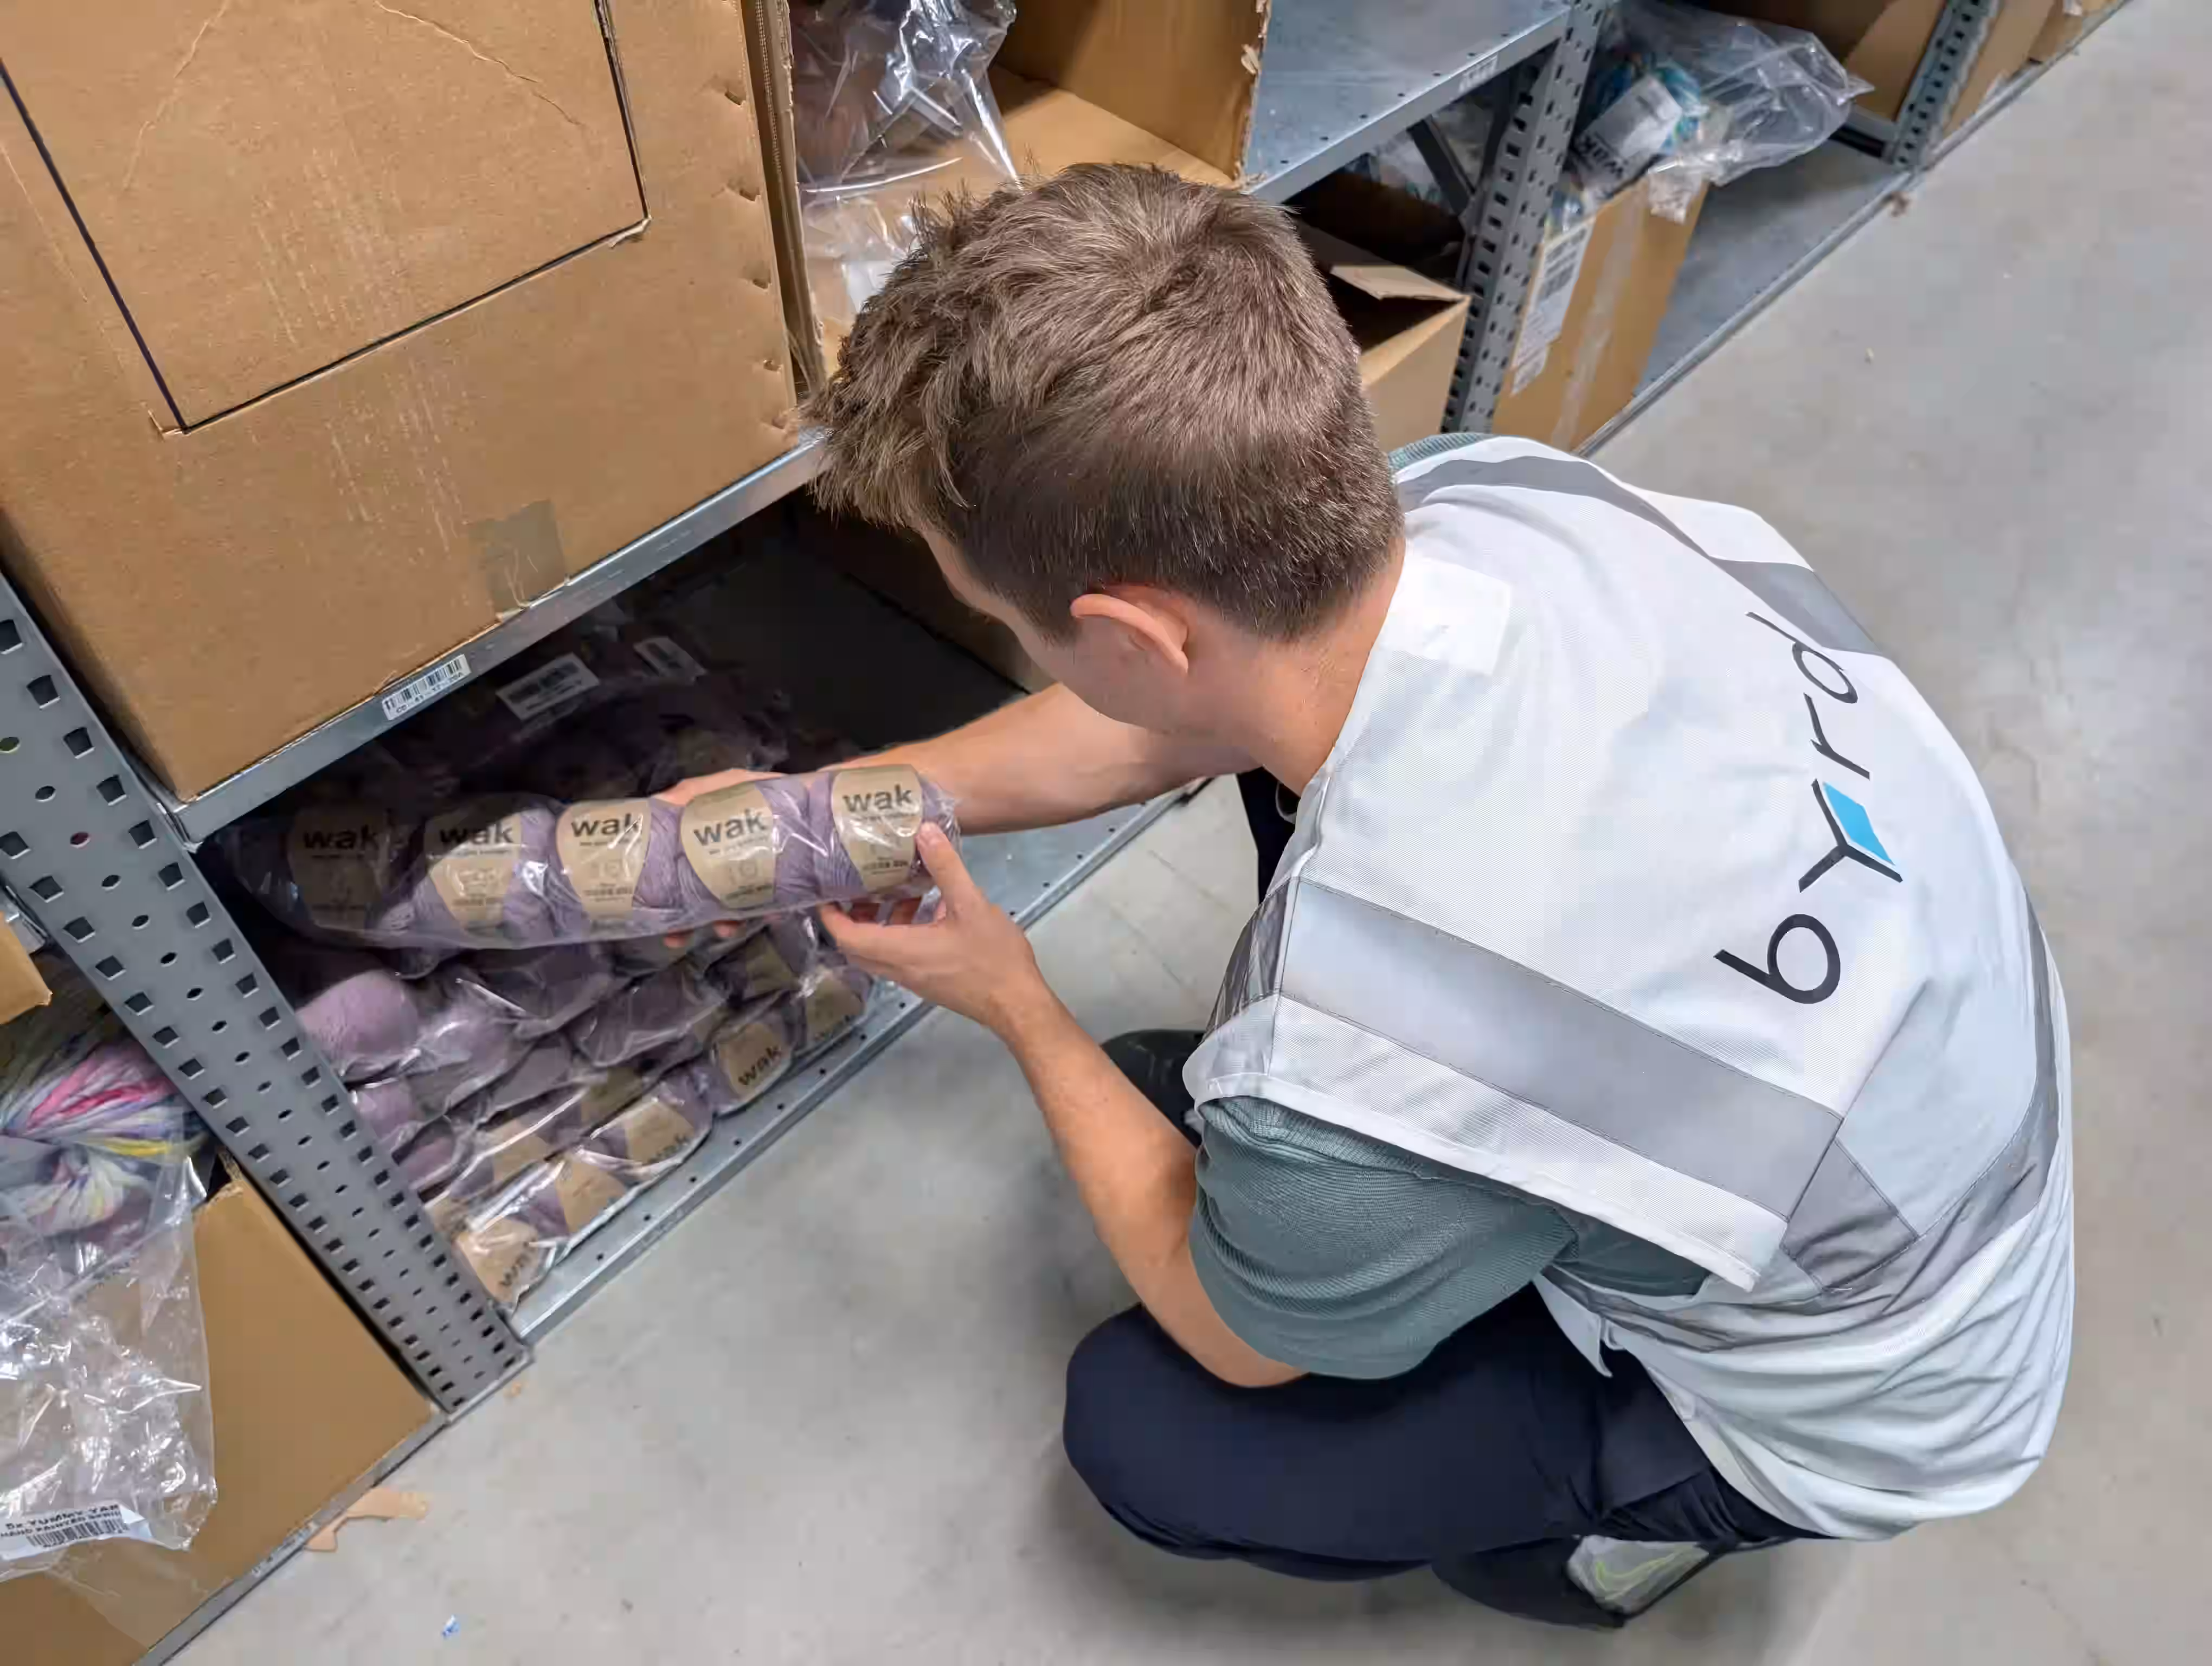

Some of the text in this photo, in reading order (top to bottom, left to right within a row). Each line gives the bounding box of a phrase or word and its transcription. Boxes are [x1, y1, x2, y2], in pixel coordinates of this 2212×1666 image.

[843, 784, 913, 812] wak
[303, 824, 379, 849] wak
[440, 821, 515, 844] wak
[571, 813, 639, 837] wak
[693, 808, 767, 846] wak
[738, 1046, 782, 1085] wak
[27, 1510, 83, 1525] YUMMY
